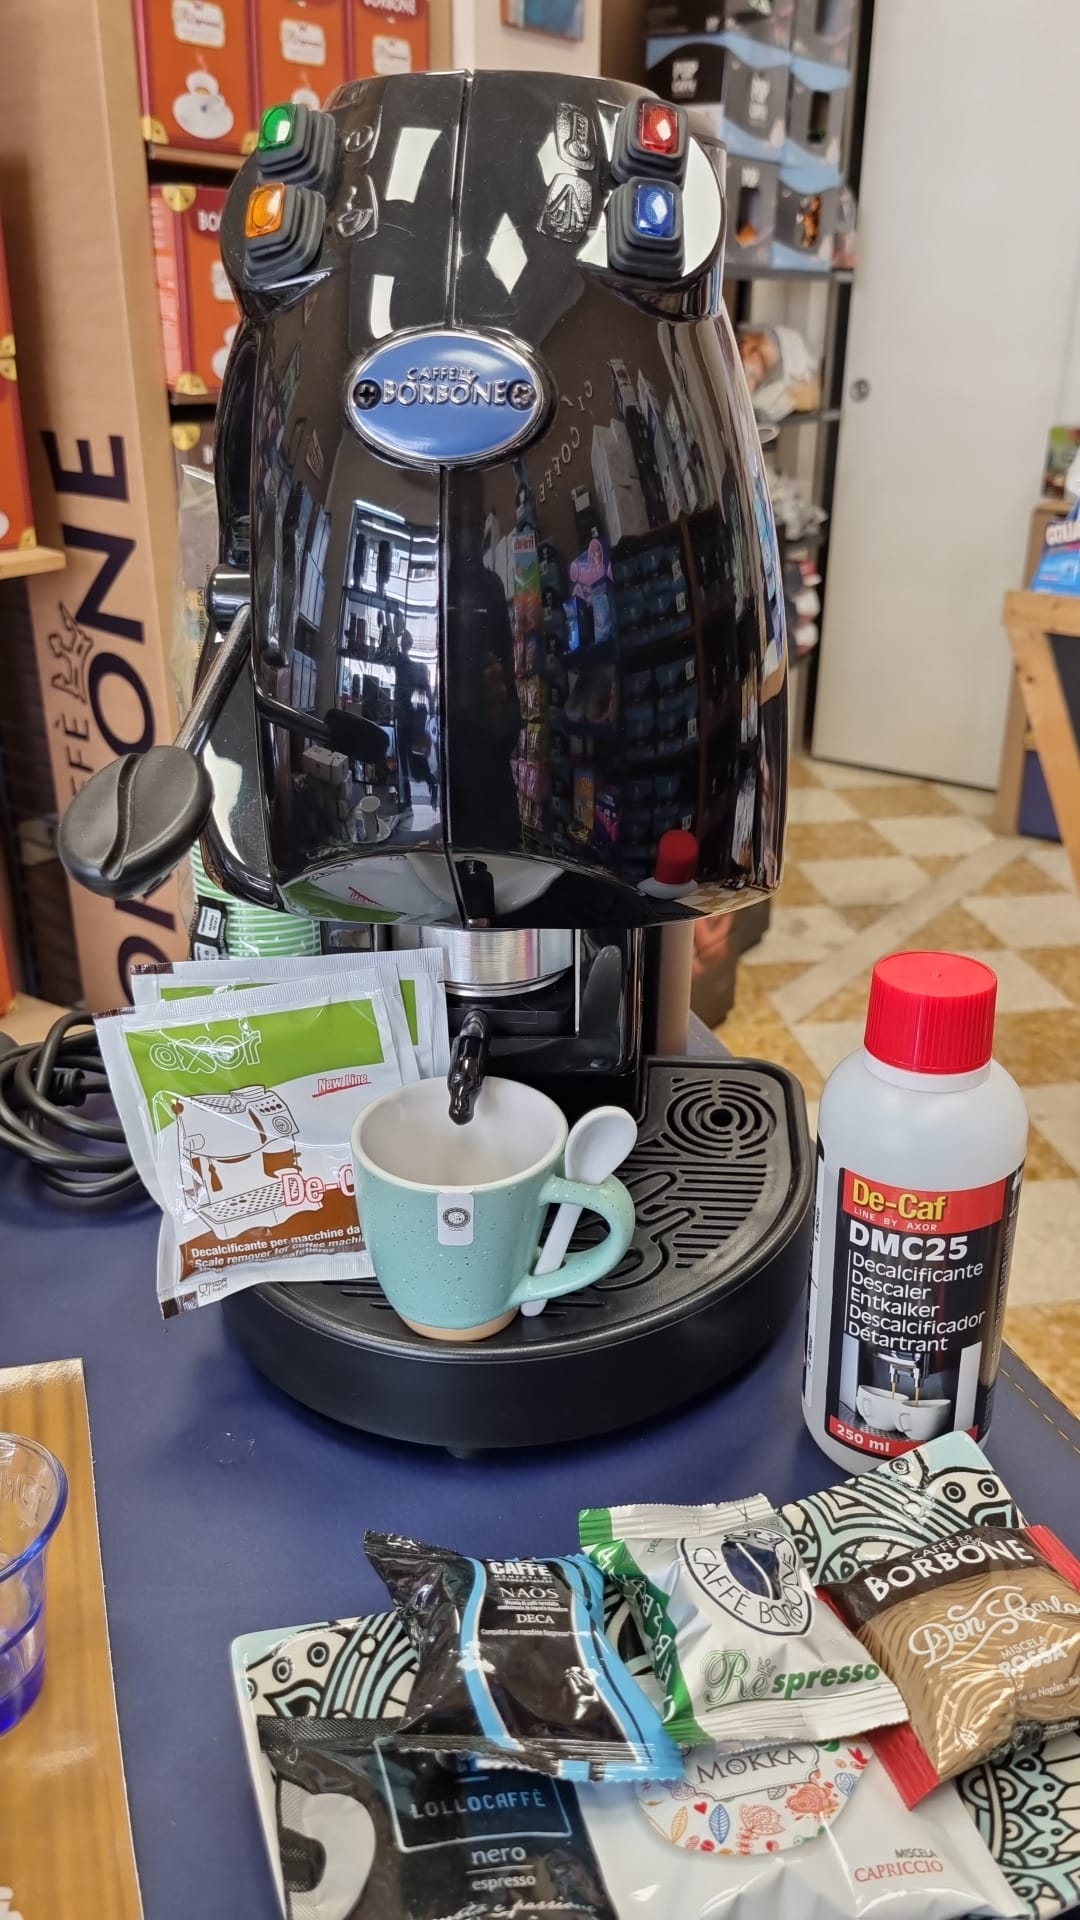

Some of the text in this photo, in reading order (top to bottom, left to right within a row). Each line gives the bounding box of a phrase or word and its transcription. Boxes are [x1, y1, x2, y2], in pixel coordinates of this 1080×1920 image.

[383, 379, 507, 406] BORBONE
[317, 1073, 368, 1093] New Line
[280, 1162, 355, 1207] De-C
[852, 1177, 947, 1221] De-Caf
[853, 1207, 938, 1232] LINE BY AXOR
[191, 1239, 268, 1259] Decalcificante
[270, 1237, 288, 1250] per
[290, 1228, 344, 1244] macchine
[193, 1257, 225, 1269] Scale
[226, 1249, 272, 1265] remover
[274, 1244, 290, 1256] for
[328, 1234, 366, 1248] machi
[849, 1219, 969, 1262] DMC25
[852, 1250, 984, 1283] Decalcificante
[851, 1269, 931, 1301] Descaler
[850, 1287, 940, 1319] Entkalker
[849, 1303, 986, 1336] Descalcificador
[848, 1320, 949, 1353] Détartrant
[836, 1424, 890, 1454] 250 ml
[911, 1537, 958, 1561] CAFFÈ
[693, 1546, 752, 1616] CAFFÈ
[864, 1538, 1034, 1602] BORBONE
[515, 1613, 556, 1625] DECA
[908, 1614, 987, 1670] Don
[1001, 1635, 1050, 1660] MISCELA
[696, 1749, 805, 1785] MOKKA
[410, 1788, 546, 1819] LOLLOCAFFÈ
[471, 1846, 527, 1865] nero
[894, 1847, 938, 1860] MISCELA
[471, 1874, 537, 1892] espresso
[853, 1859, 945, 1883] CAPRICCIO
